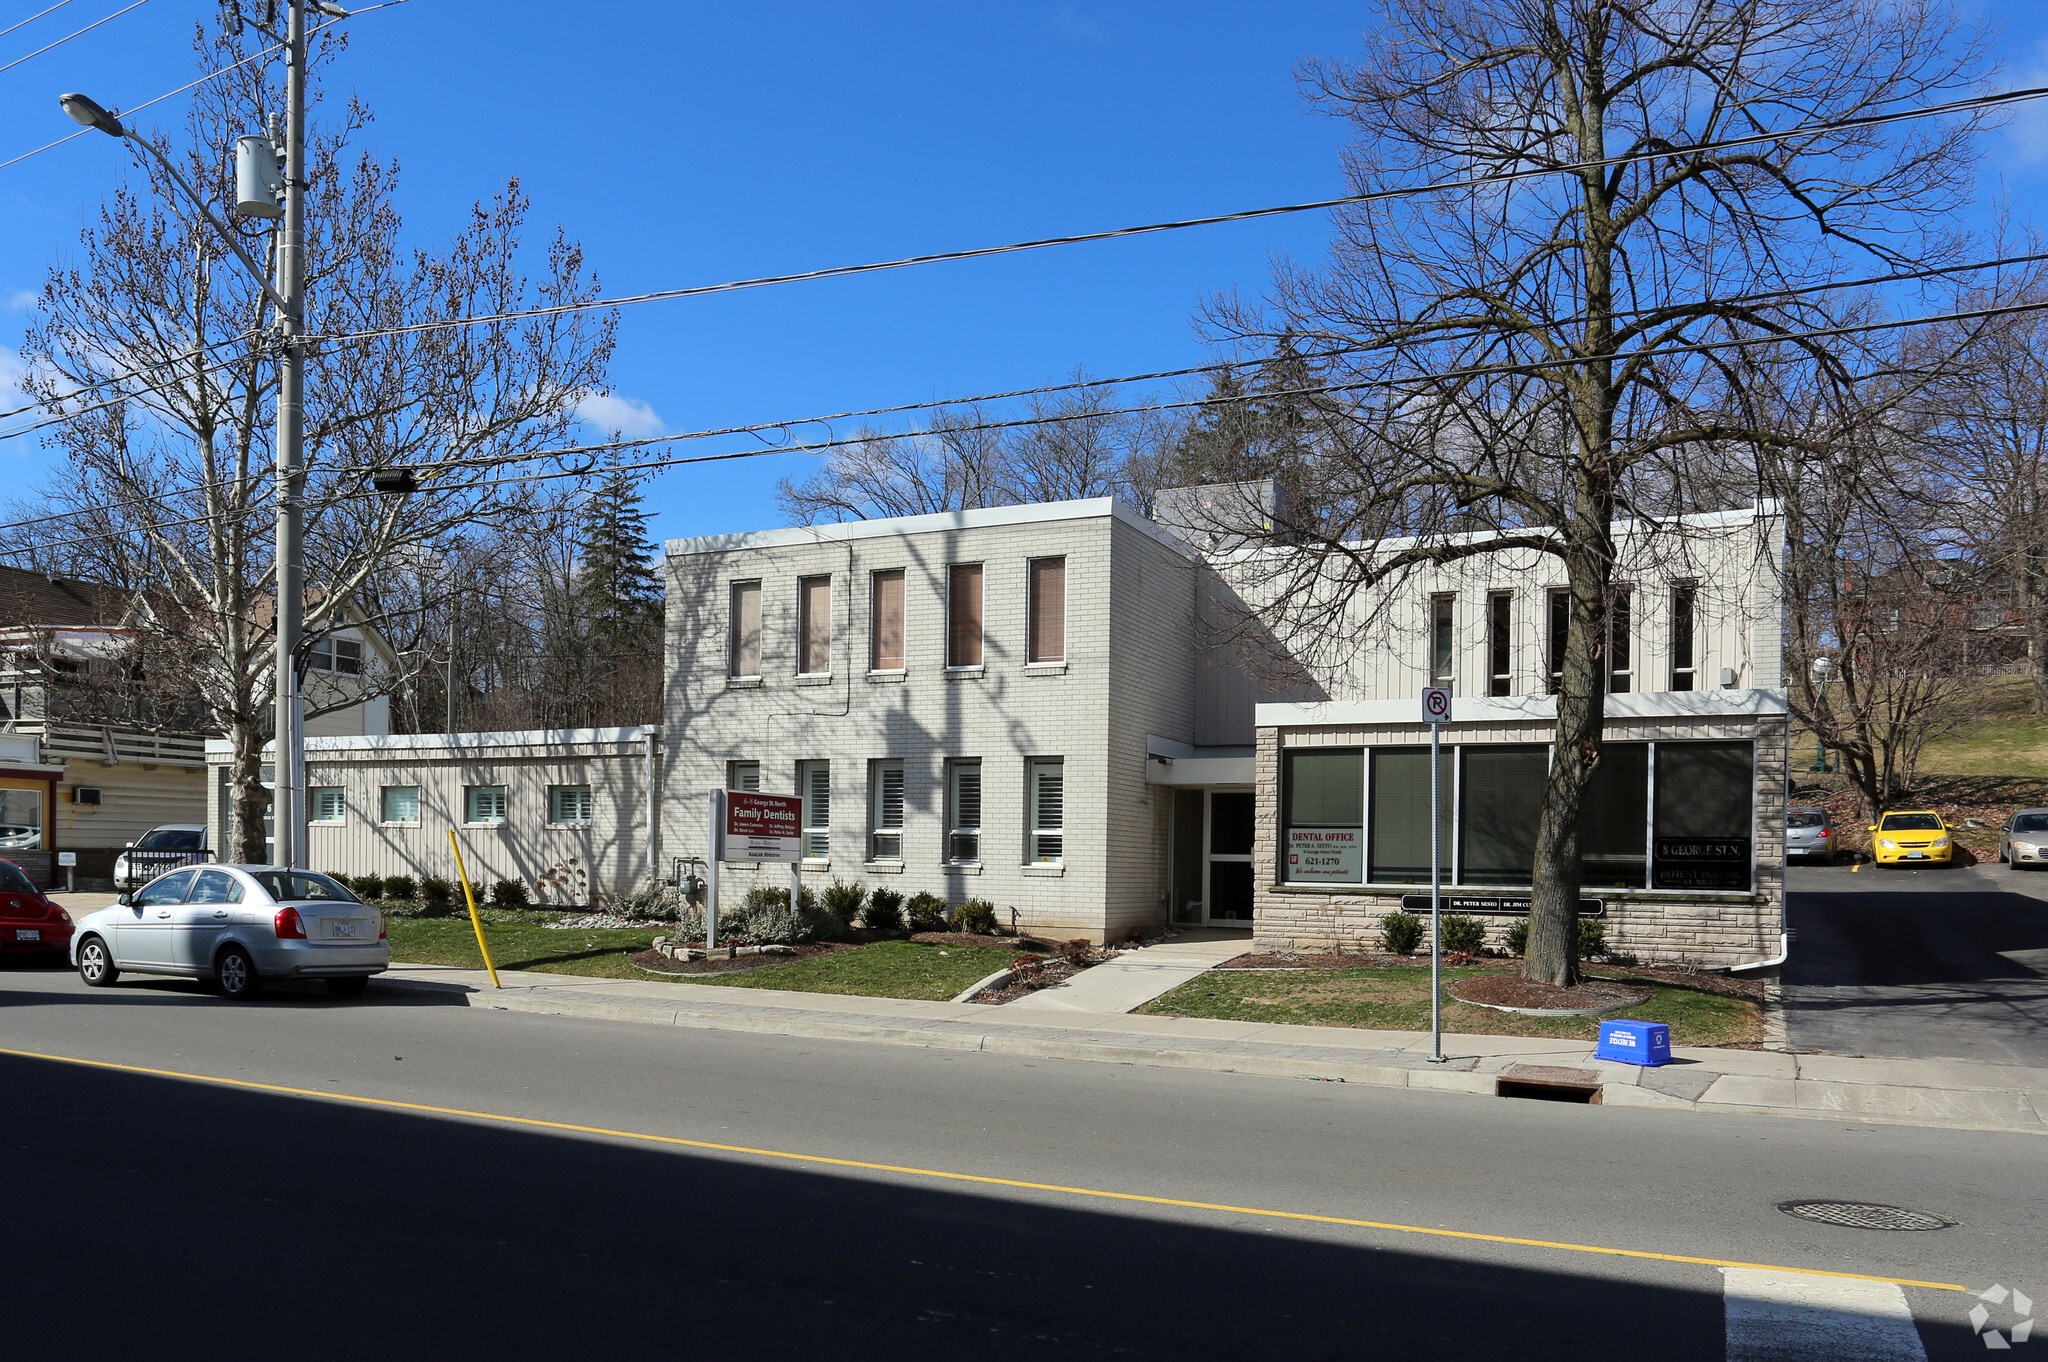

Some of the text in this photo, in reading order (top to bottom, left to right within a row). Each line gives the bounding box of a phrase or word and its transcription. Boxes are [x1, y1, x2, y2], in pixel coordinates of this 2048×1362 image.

[754, 799, 768, 807] George
[266, 804, 272, 812] 6
[734, 807, 795, 821] Family Dentists
[1292, 832, 1354, 842] DENTAL OFFICE
[1663, 845, 1668, 856] 8
[1671, 845, 1713, 856] GEORGE
[1305, 857, 1340, 865] 621-1270
[1660, 870, 1742, 879] PATIENT PARKING
[1609, 1038, 1628, 1046] RECYCLE
